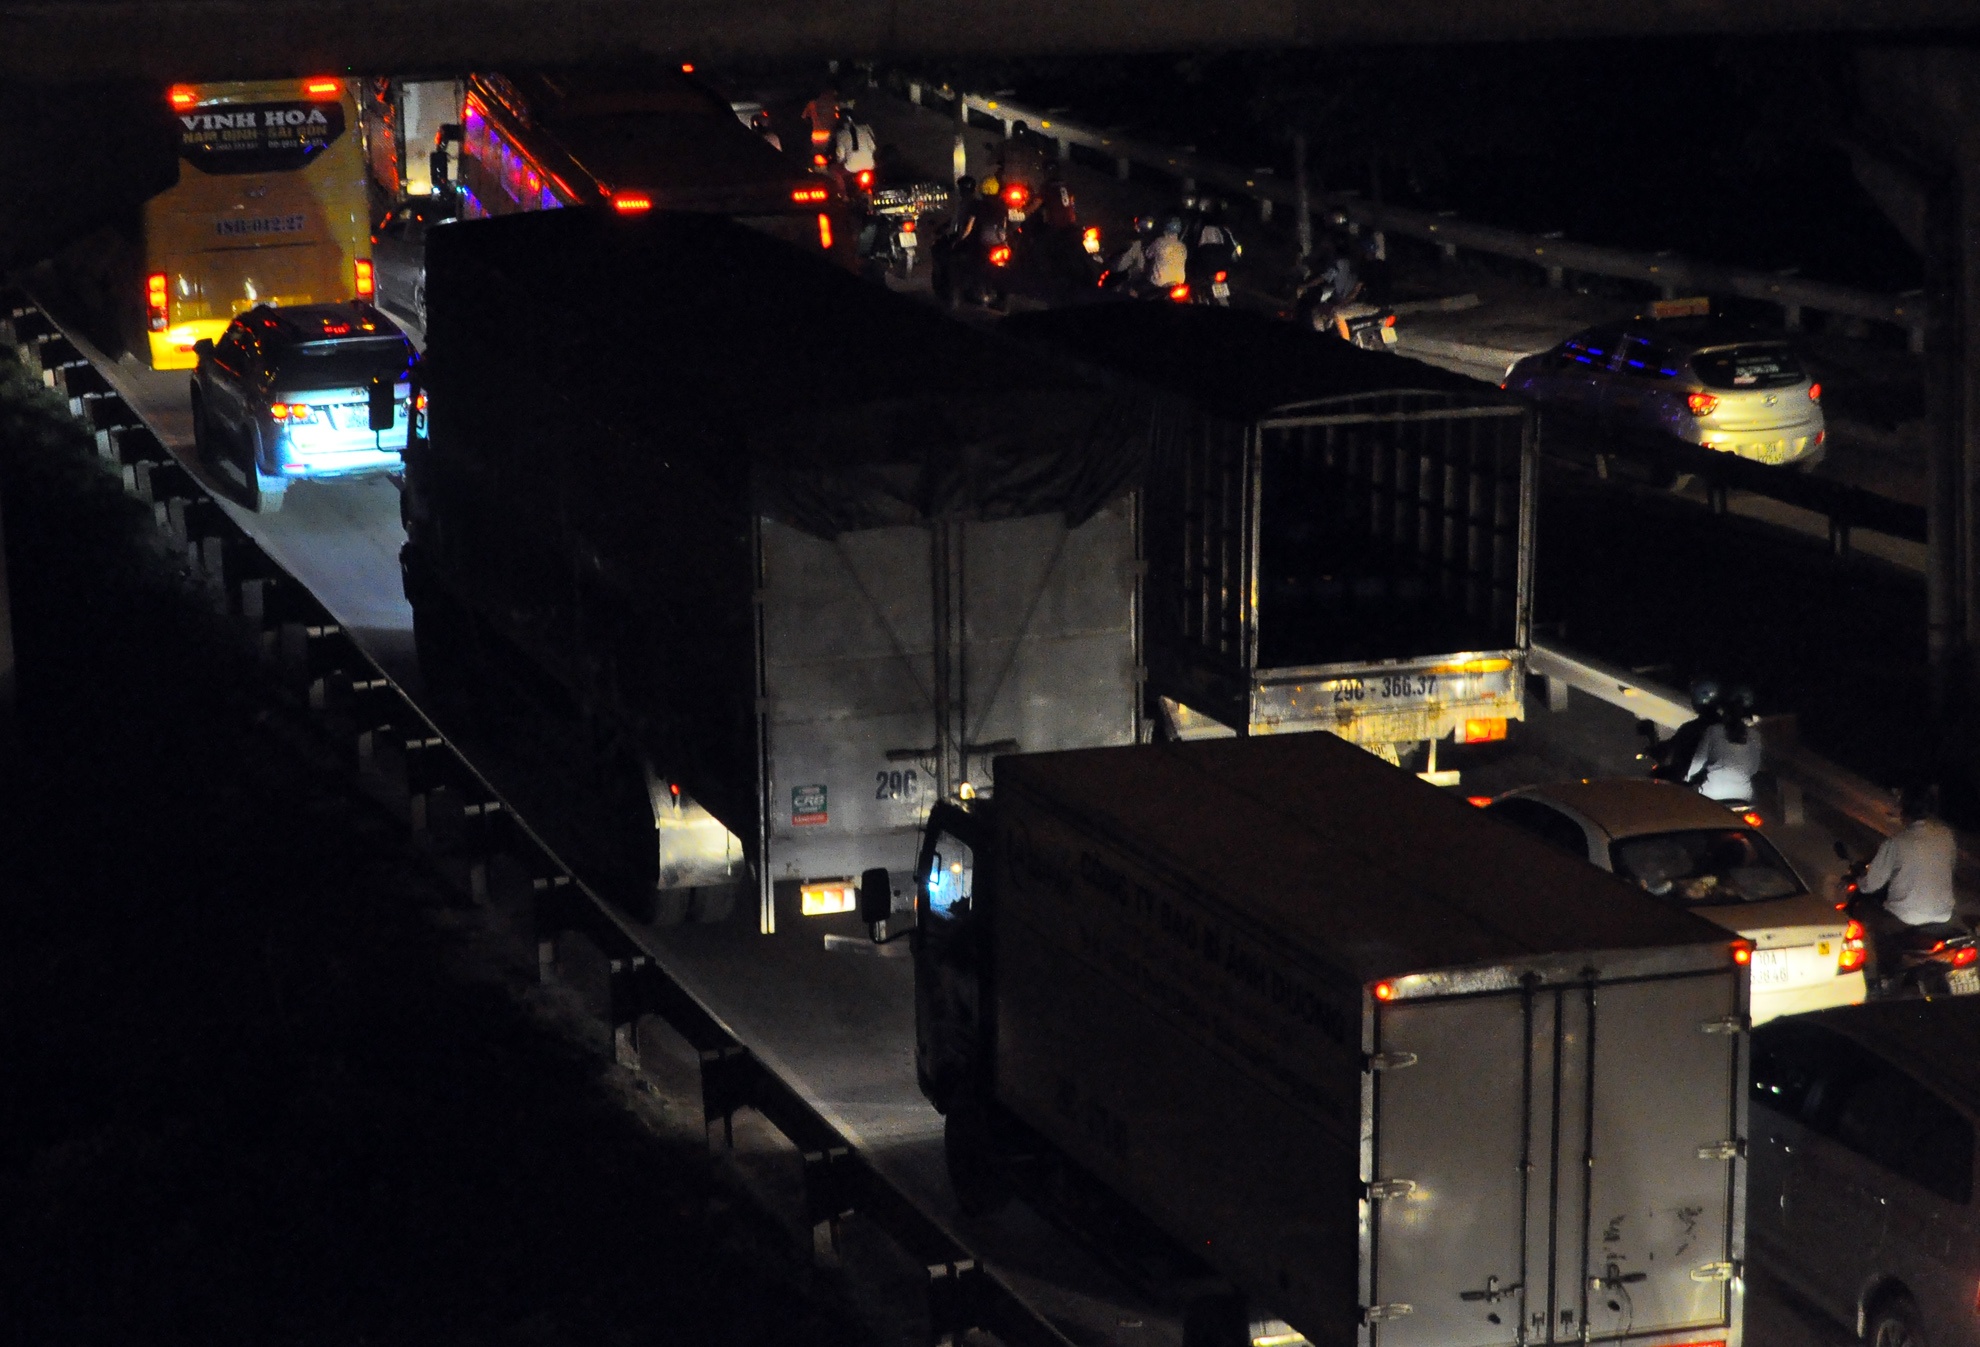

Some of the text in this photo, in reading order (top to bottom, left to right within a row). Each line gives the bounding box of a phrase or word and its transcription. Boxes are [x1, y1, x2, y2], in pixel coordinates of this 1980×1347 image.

[179, 108, 328, 131] VINH HOA
[1333, 680, 1365, 702] 29C
[1381, 675, 1437, 699] 366.37
[875, 770, 918, 800] 29C
